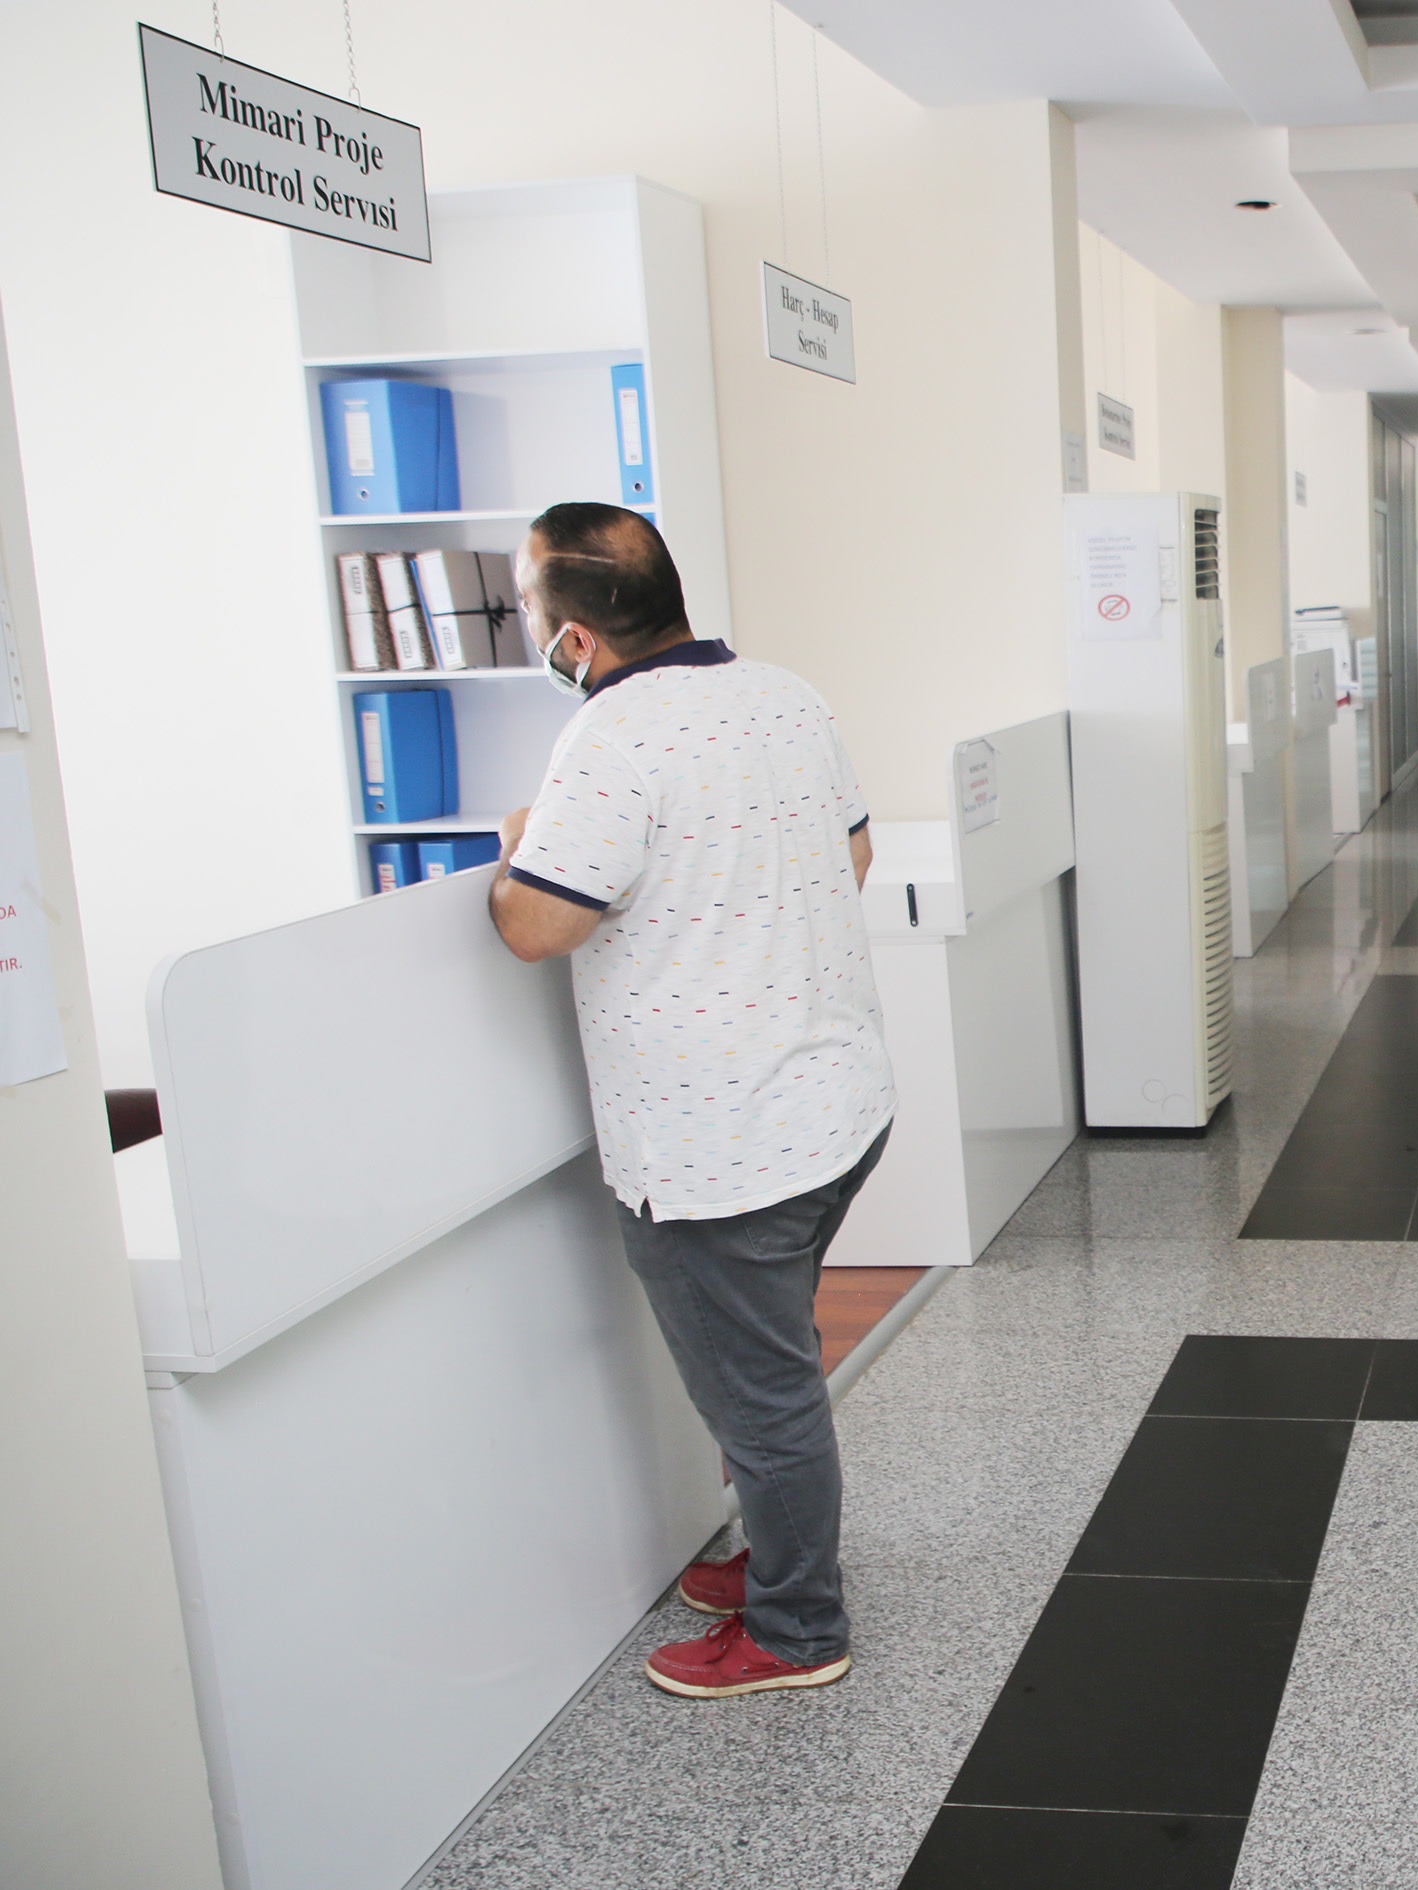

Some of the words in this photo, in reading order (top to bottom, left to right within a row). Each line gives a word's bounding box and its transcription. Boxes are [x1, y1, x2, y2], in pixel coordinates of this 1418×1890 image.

[196, 72, 306, 146] Mimari
[313, 115, 384, 176] Proje
[191, 136, 305, 206] Kontrol
[781, 286, 805, 322] Harç
[812, 299, 839, 334] Hesap
[798, 330, 828, 361] Servisi
